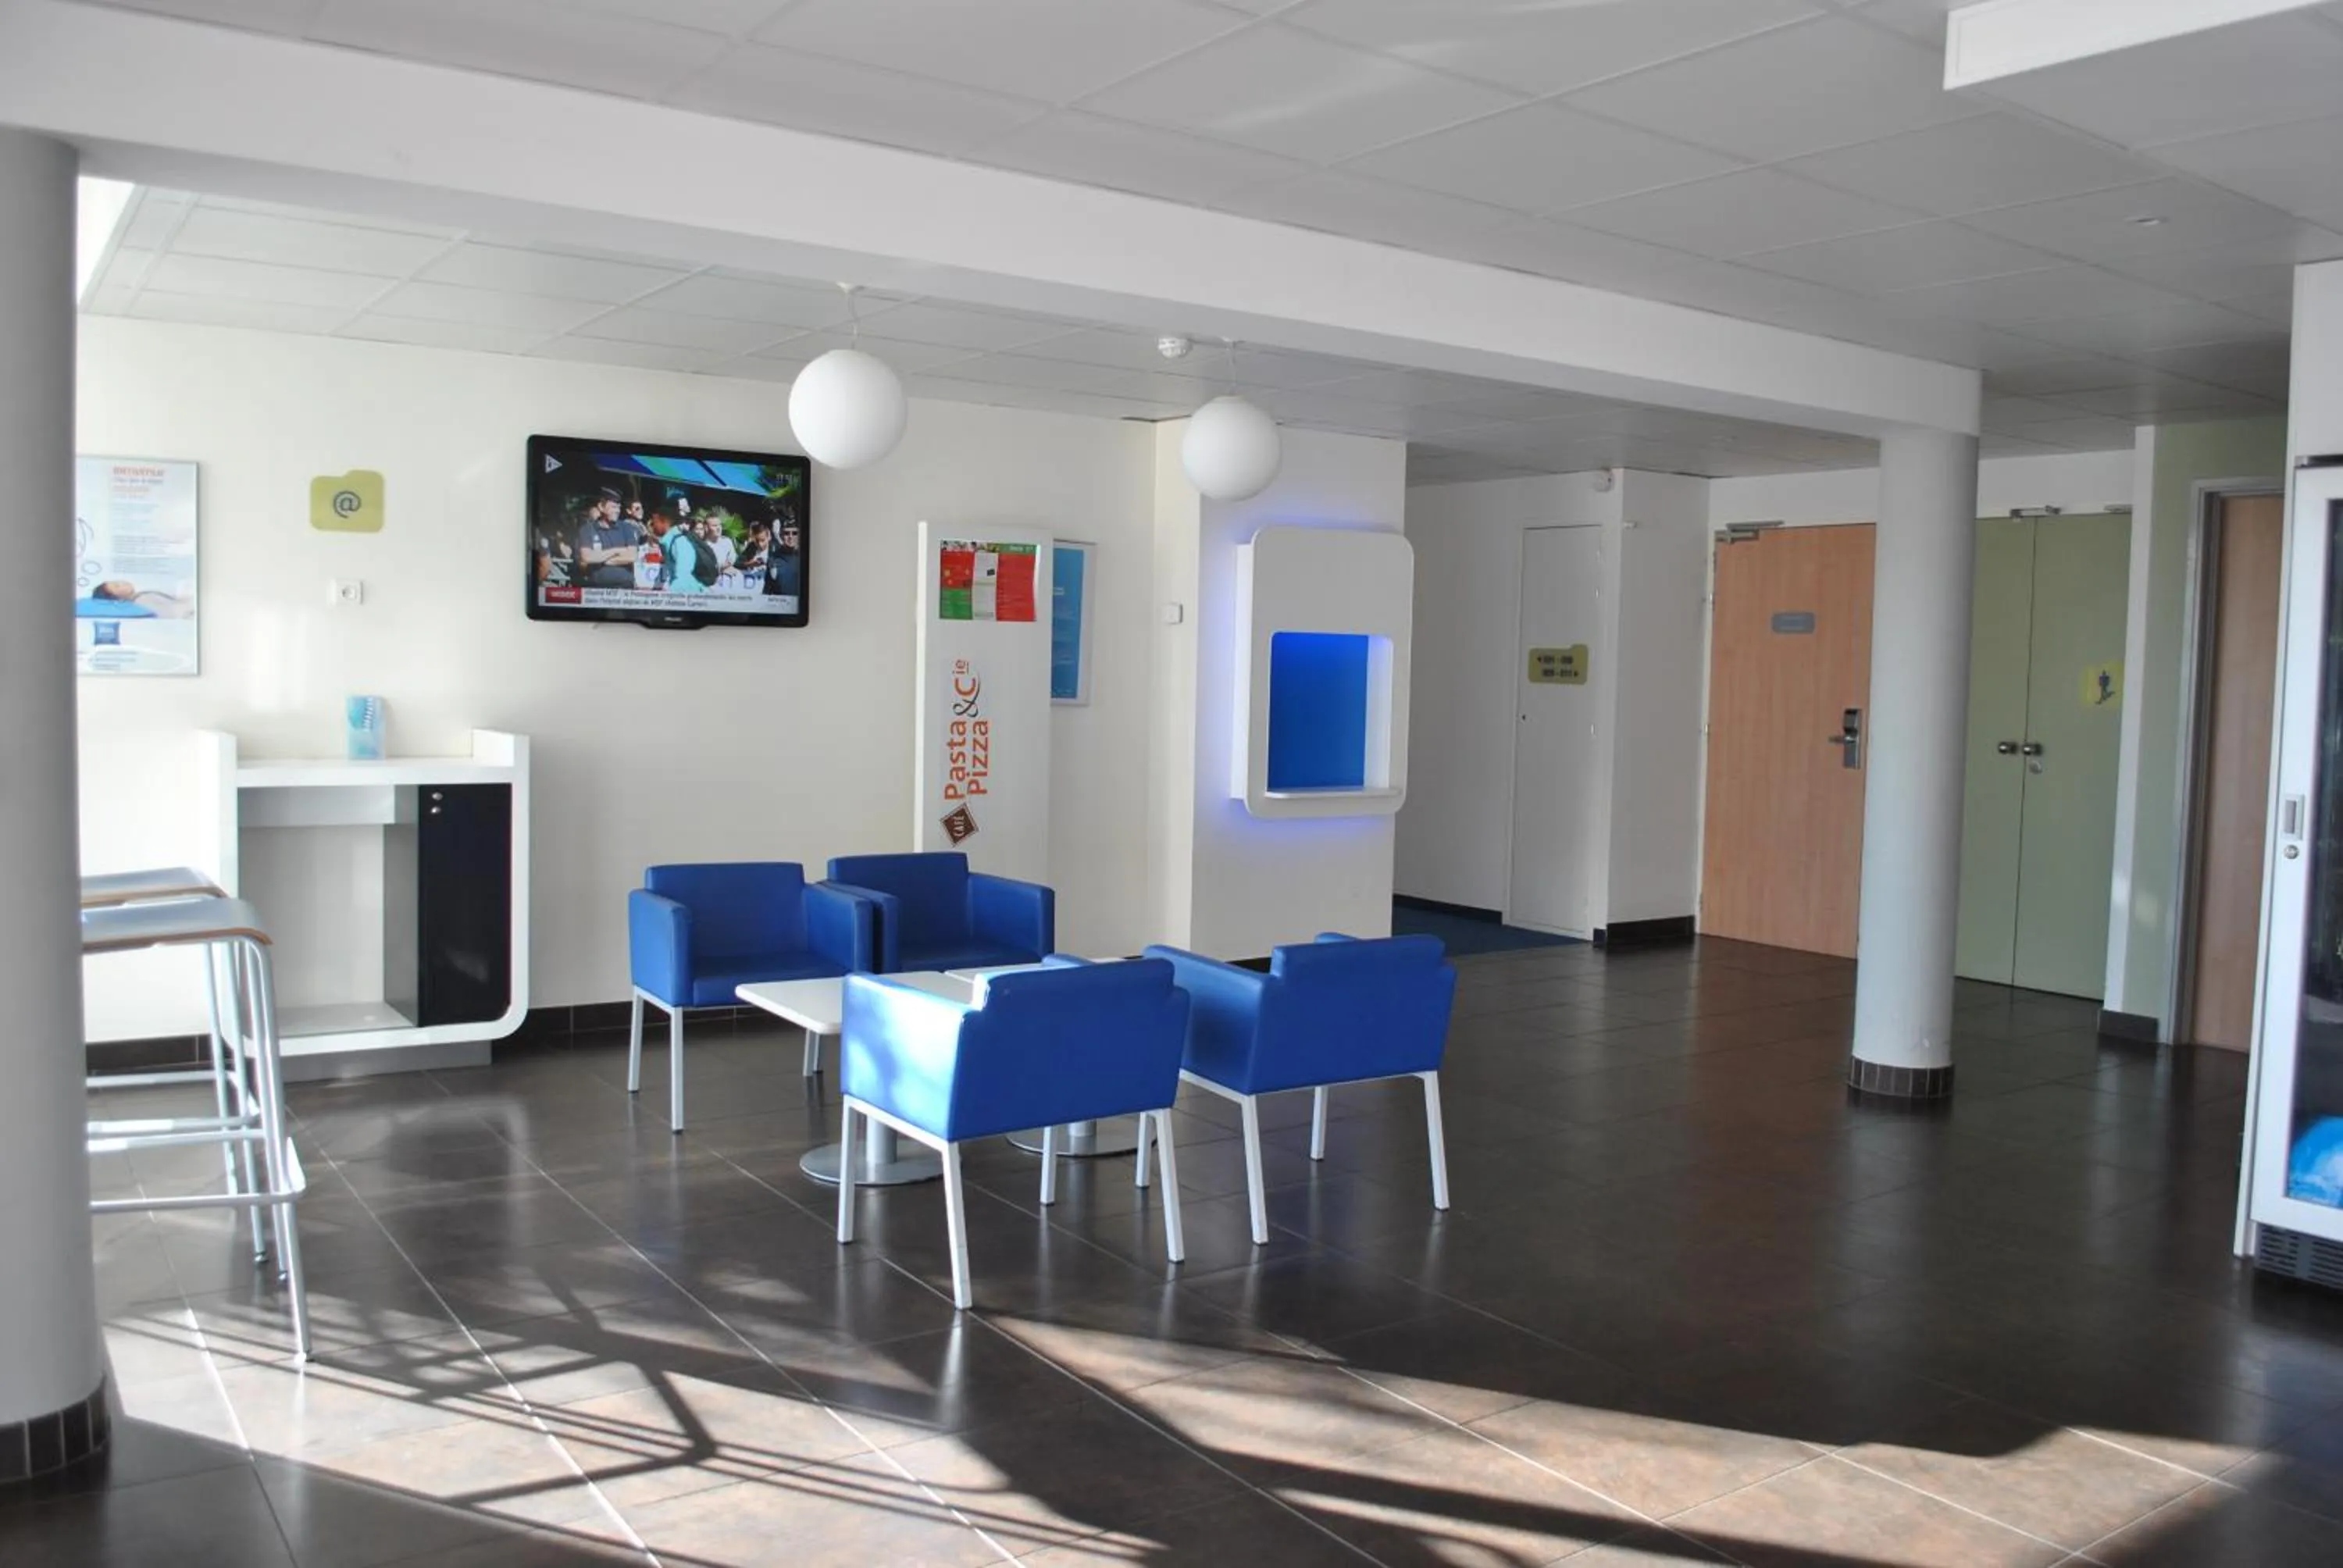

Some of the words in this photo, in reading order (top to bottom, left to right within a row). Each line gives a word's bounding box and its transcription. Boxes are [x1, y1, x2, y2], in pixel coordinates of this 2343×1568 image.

[333, 490, 361, 519] @
[944, 721, 967, 800] Pasta
[966, 721, 988, 794] Pizza
